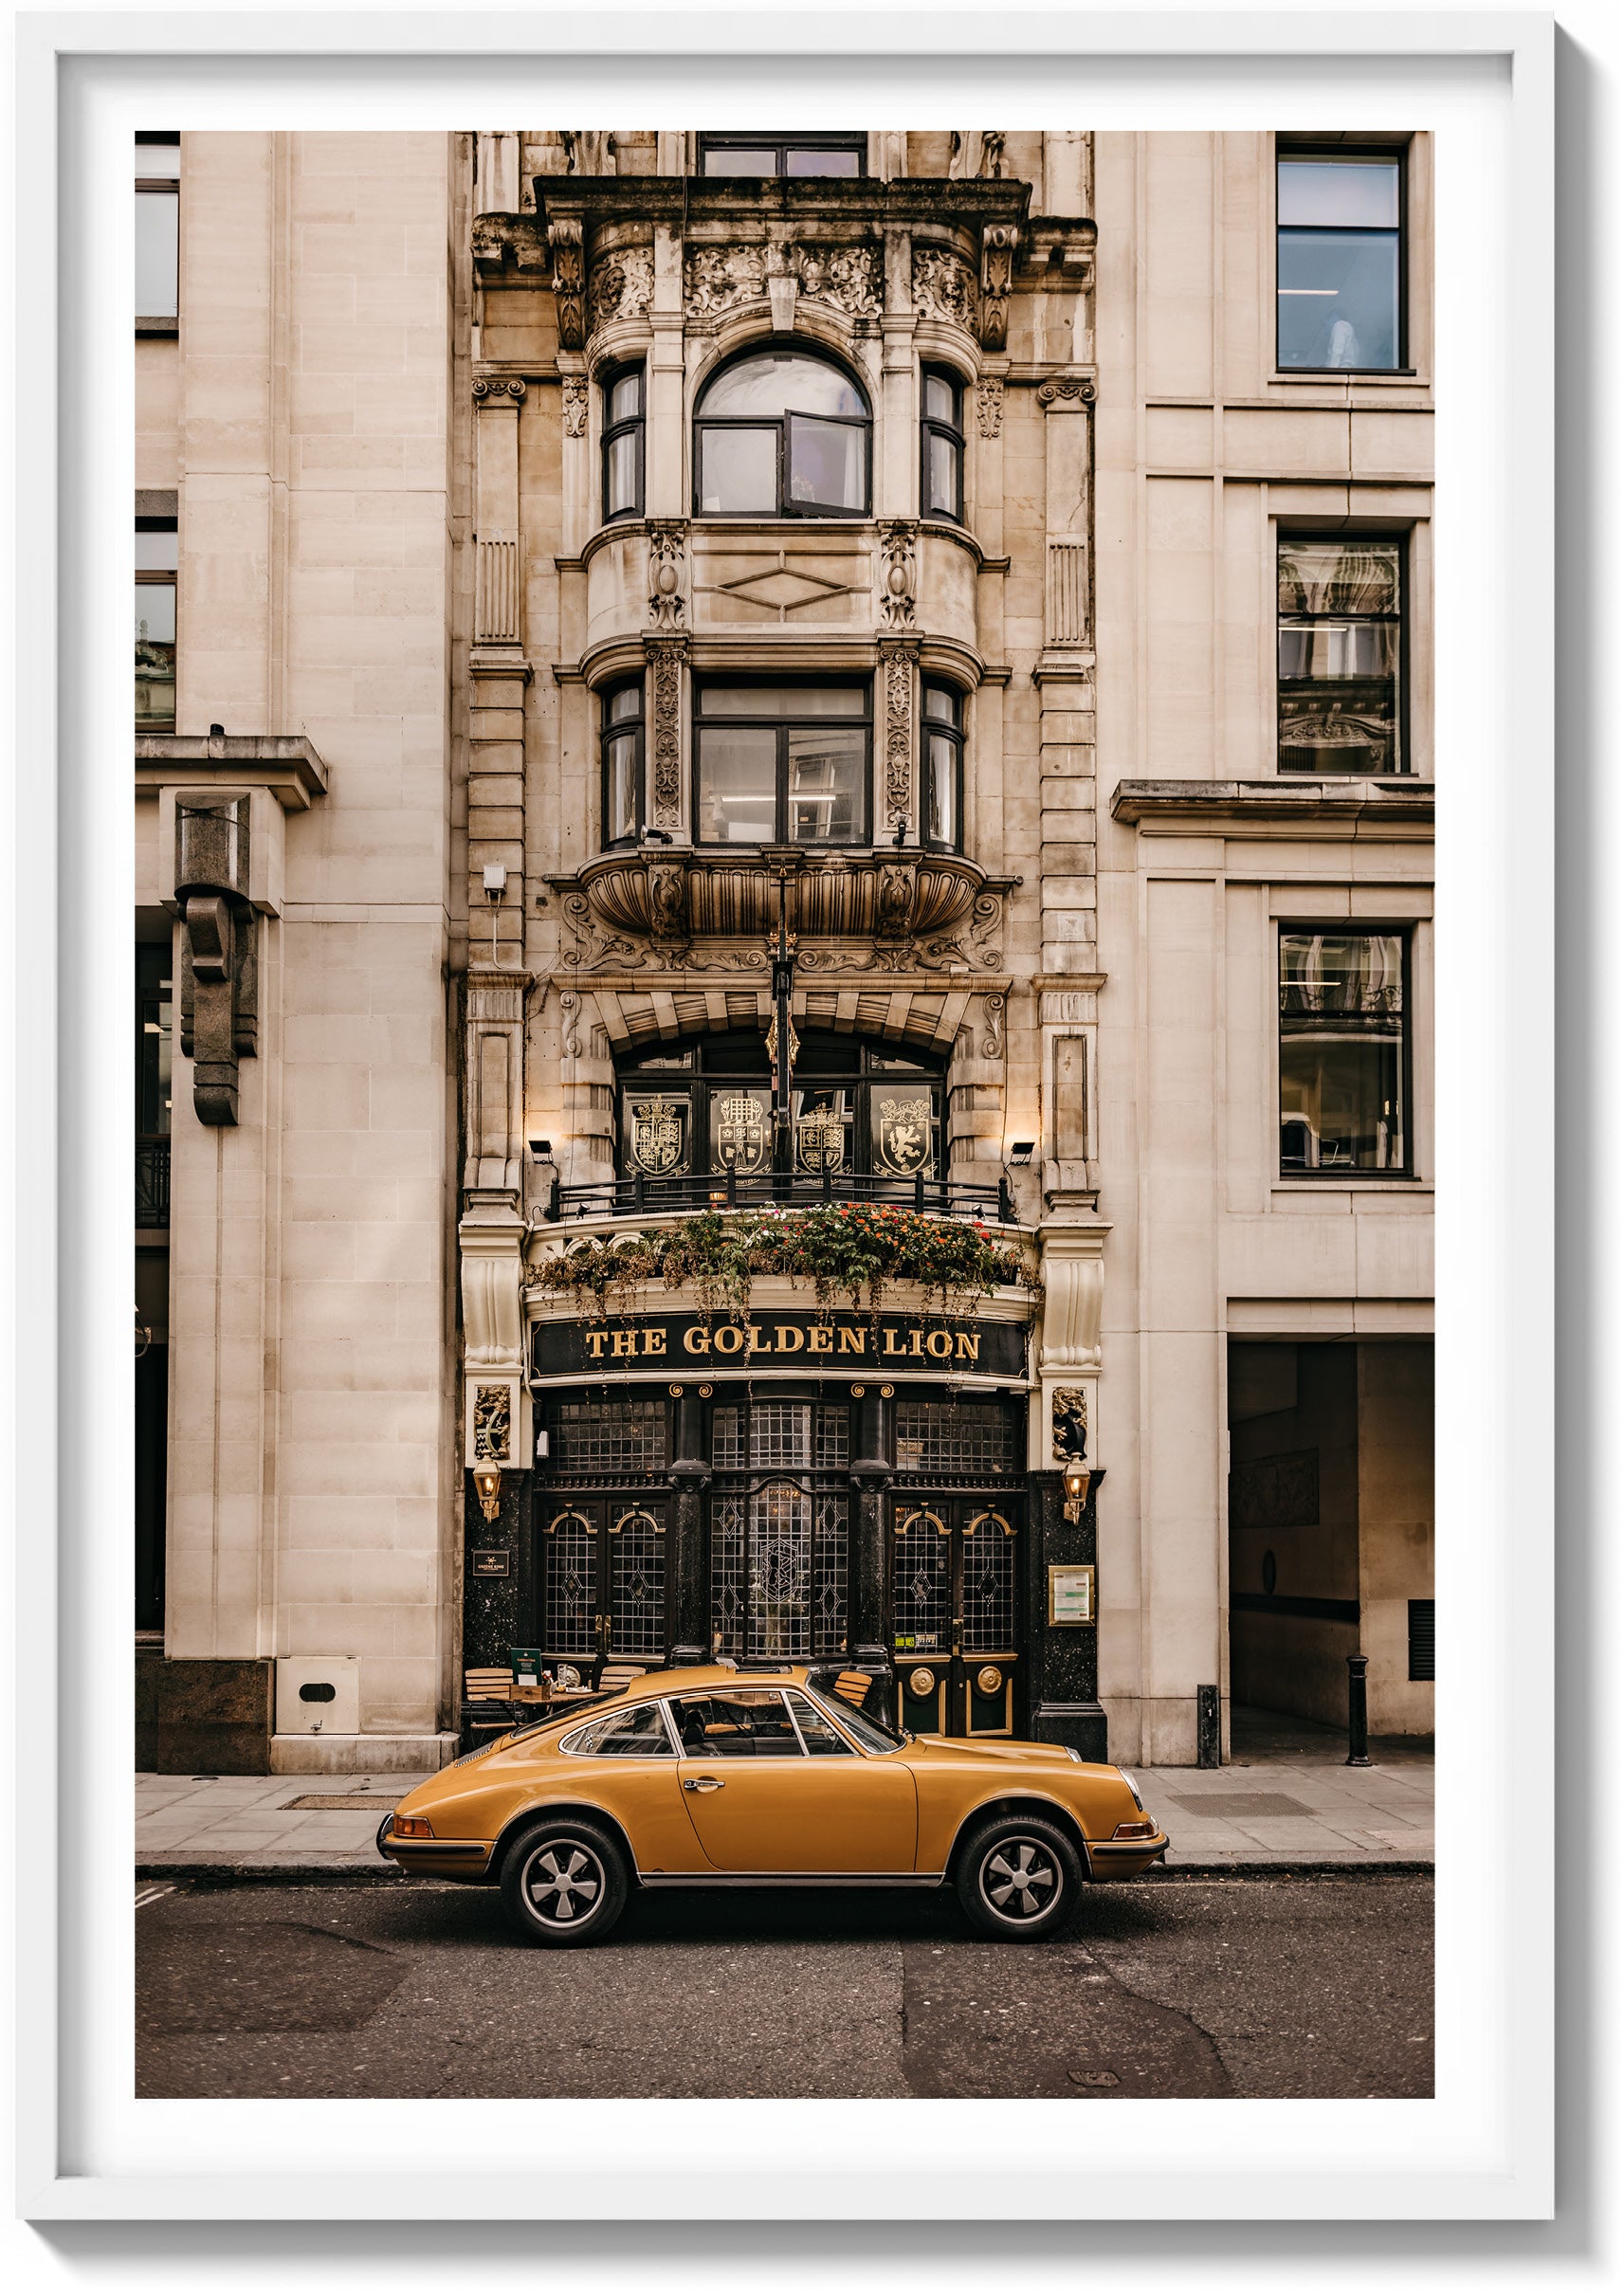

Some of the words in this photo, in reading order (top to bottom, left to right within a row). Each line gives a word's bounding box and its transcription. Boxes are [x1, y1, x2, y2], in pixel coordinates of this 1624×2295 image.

[585, 1328, 666, 1358] THE
[683, 1323, 867, 1356] GOLDEN
[883, 1329, 982, 1360] LION
